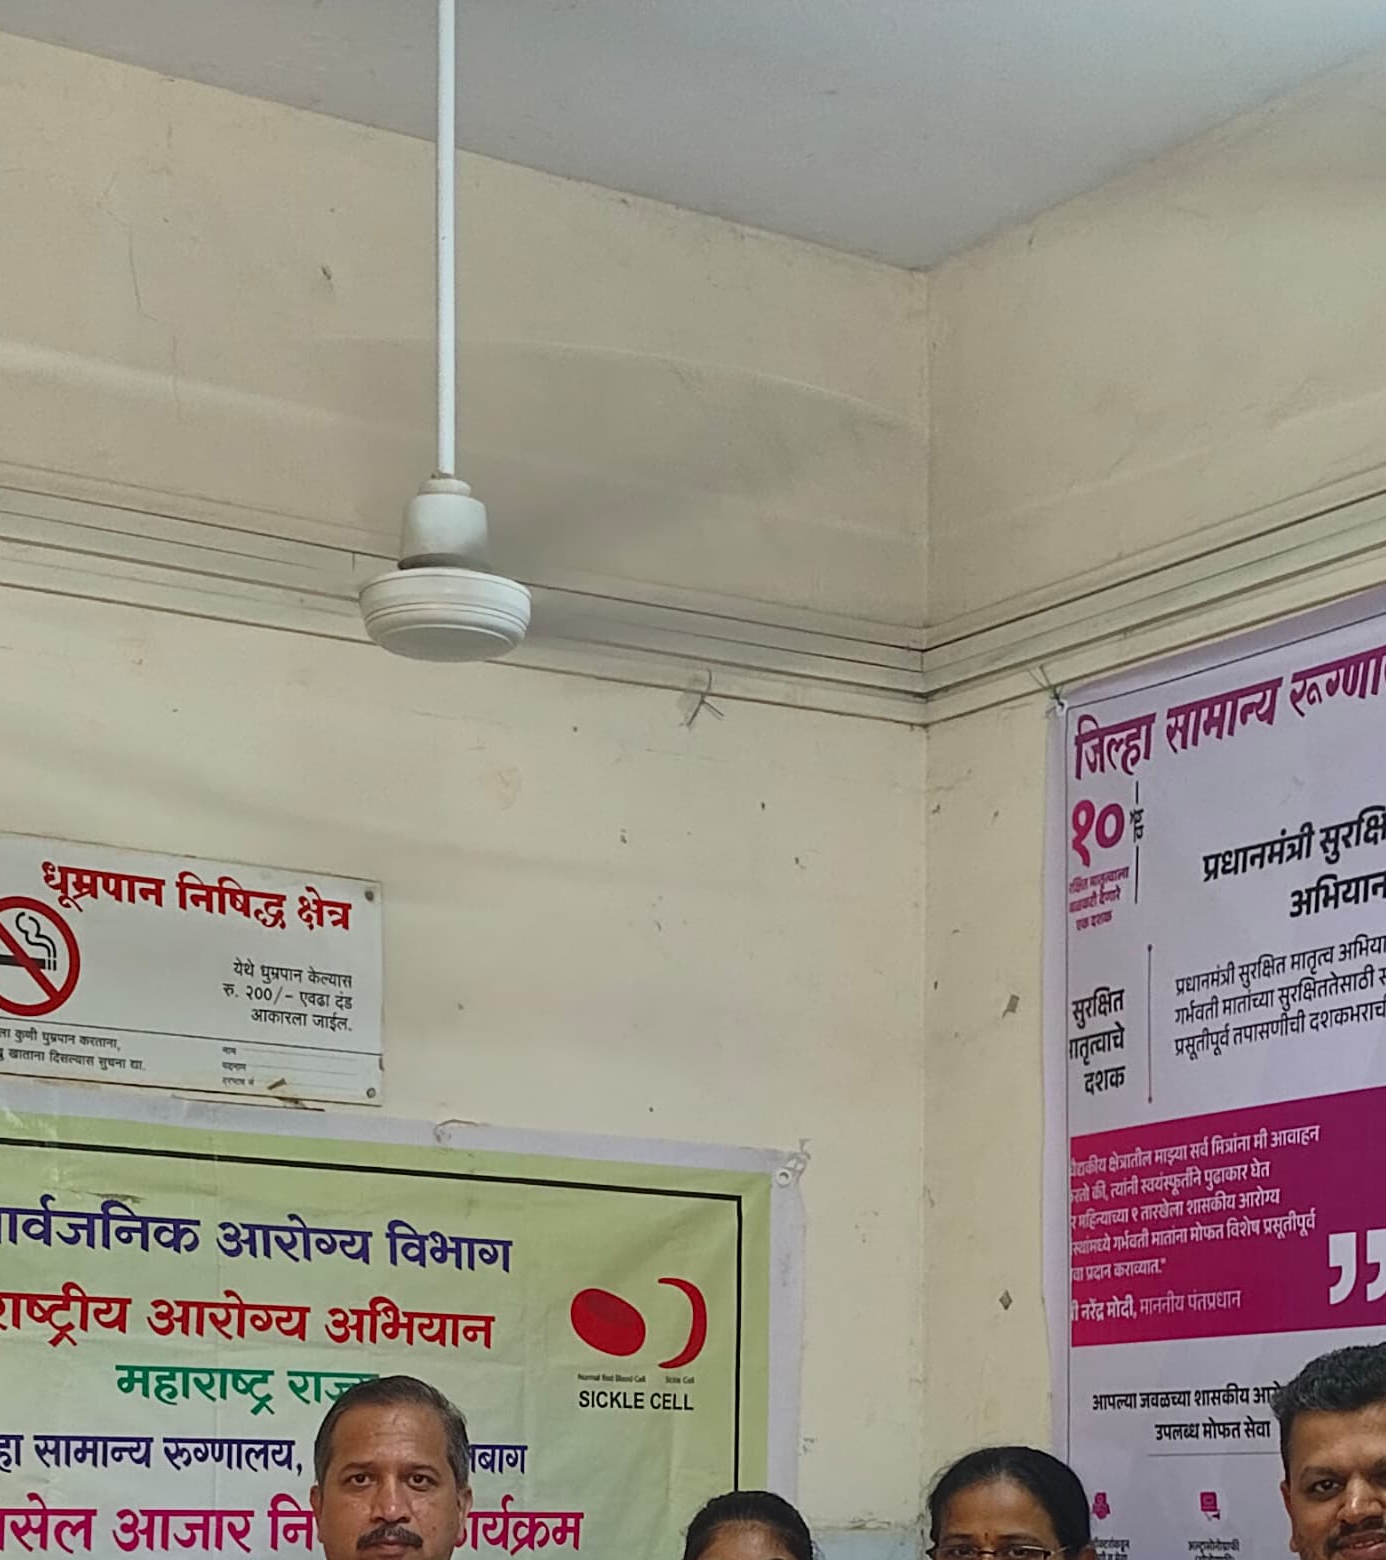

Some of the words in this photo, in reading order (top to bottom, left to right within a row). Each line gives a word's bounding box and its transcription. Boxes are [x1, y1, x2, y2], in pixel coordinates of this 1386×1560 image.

[1074, 712, 1155, 780] जिल्हा
[1166, 676, 1283, 750] सामान्य
[1072, 800, 1125, 868] १०
[1202, 815, 1314, 887] प्रधानमंत्री
[42, 861, 165, 912] धूम्रपान
[177, 871, 286, 929] निषिद्ध
[297, 886, 351, 931] क्षेत्र
[233, 958, 254, 977] येथे
[308, 967, 352, 988] केल्यास
[1175, 964, 1234, 997] प्रधानमंत्री
[1238, 954, 1287, 990] सुरक्षित
[251, 1007, 307, 1028] आकारला
[334, 989, 352, 1011] दंड
[1071, 986, 1125, 1030] सुरक्षित
[1084, 1064, 1126, 1096] दशक
[1270, 1124, 1321, 1148] आवाहन
[216, 1213, 372, 1266] आरोग्य
[386, 1220, 513, 1274] विभाग
[147, 1289, 310, 1343] आरोग्य
[325, 1296, 495, 1350] अभियान
[116, 1363, 273, 1416] महाराष्ट्र
[579, 1390, 645, 1410] SICKLE
[650, 1393, 694, 1411] CELL
[1092, 1391, 1138, 1412] आपल्या
[1193, 1382, 1250, 1408] शासकीय
[1155, 1422, 1200, 1442] उपलब्ध
[1202, 1416, 1242, 1440] मोफत
[1244, 1416, 1271, 1439] सेवा
[33, 1434, 152, 1470] सामान्य
[113, 1506, 254, 1554] आजार
